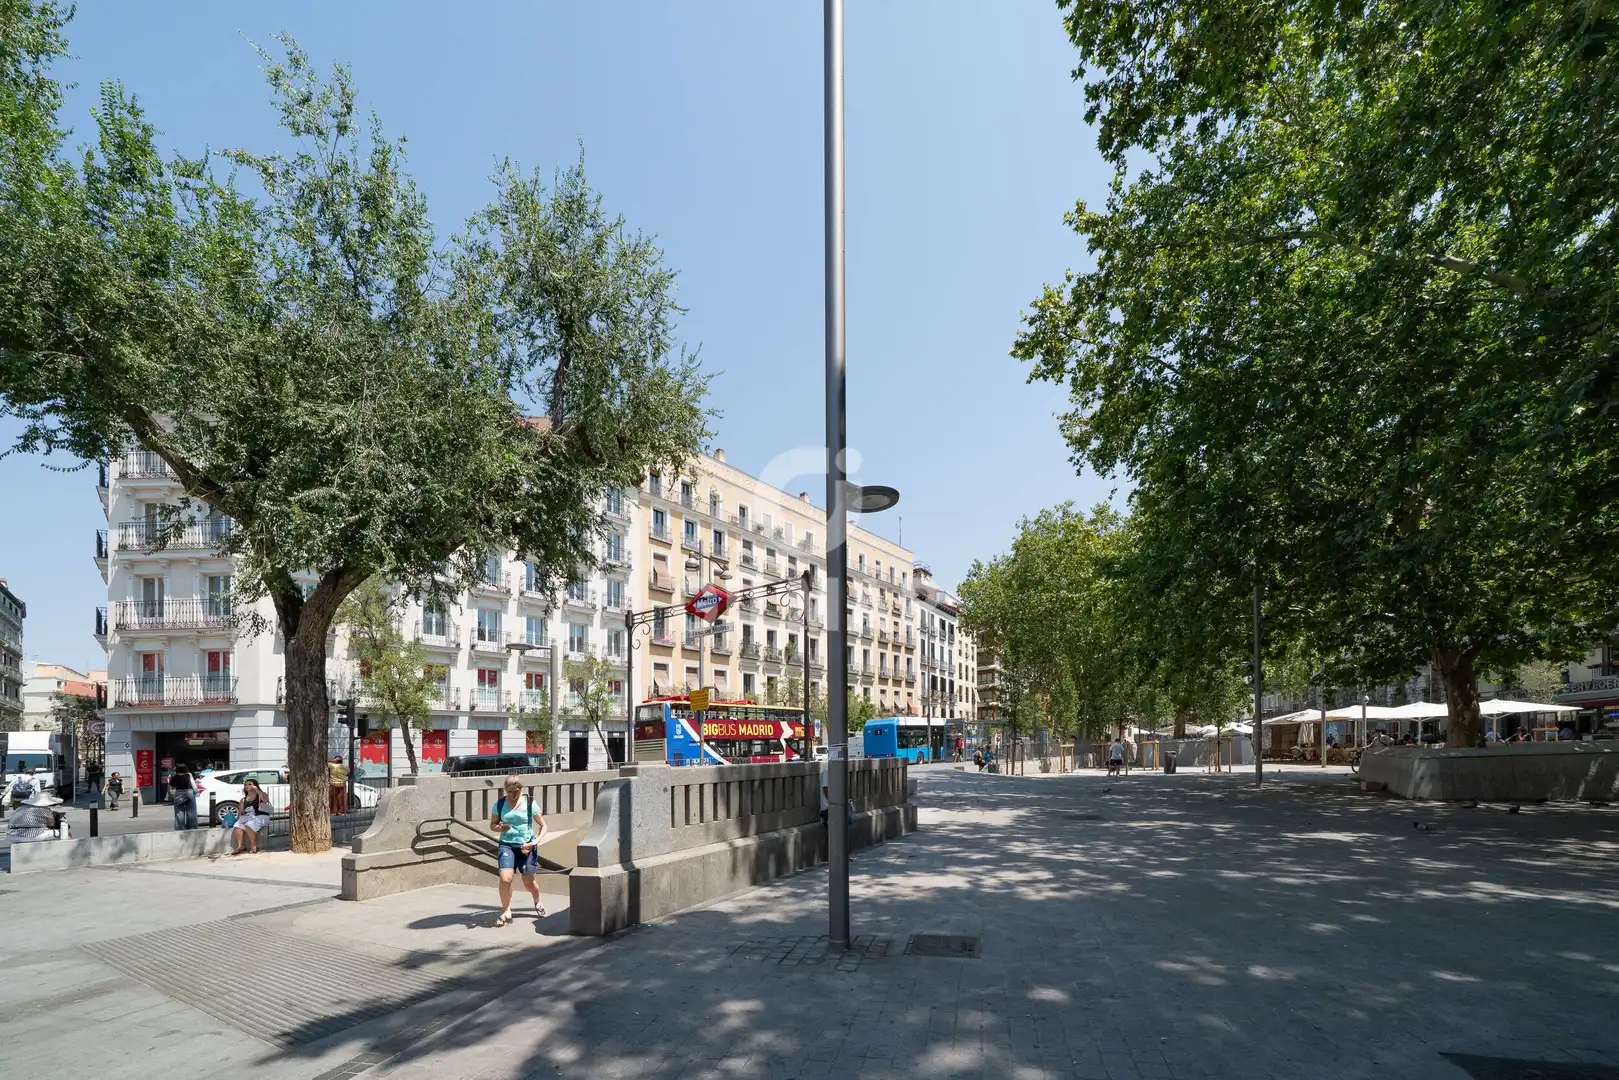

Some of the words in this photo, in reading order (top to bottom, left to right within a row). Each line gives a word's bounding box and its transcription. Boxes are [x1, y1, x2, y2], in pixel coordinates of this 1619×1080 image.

[697, 597, 717, 607] Metro
[712, 625, 730, 633] Molina
[739, 724, 774, 736] MADRID
